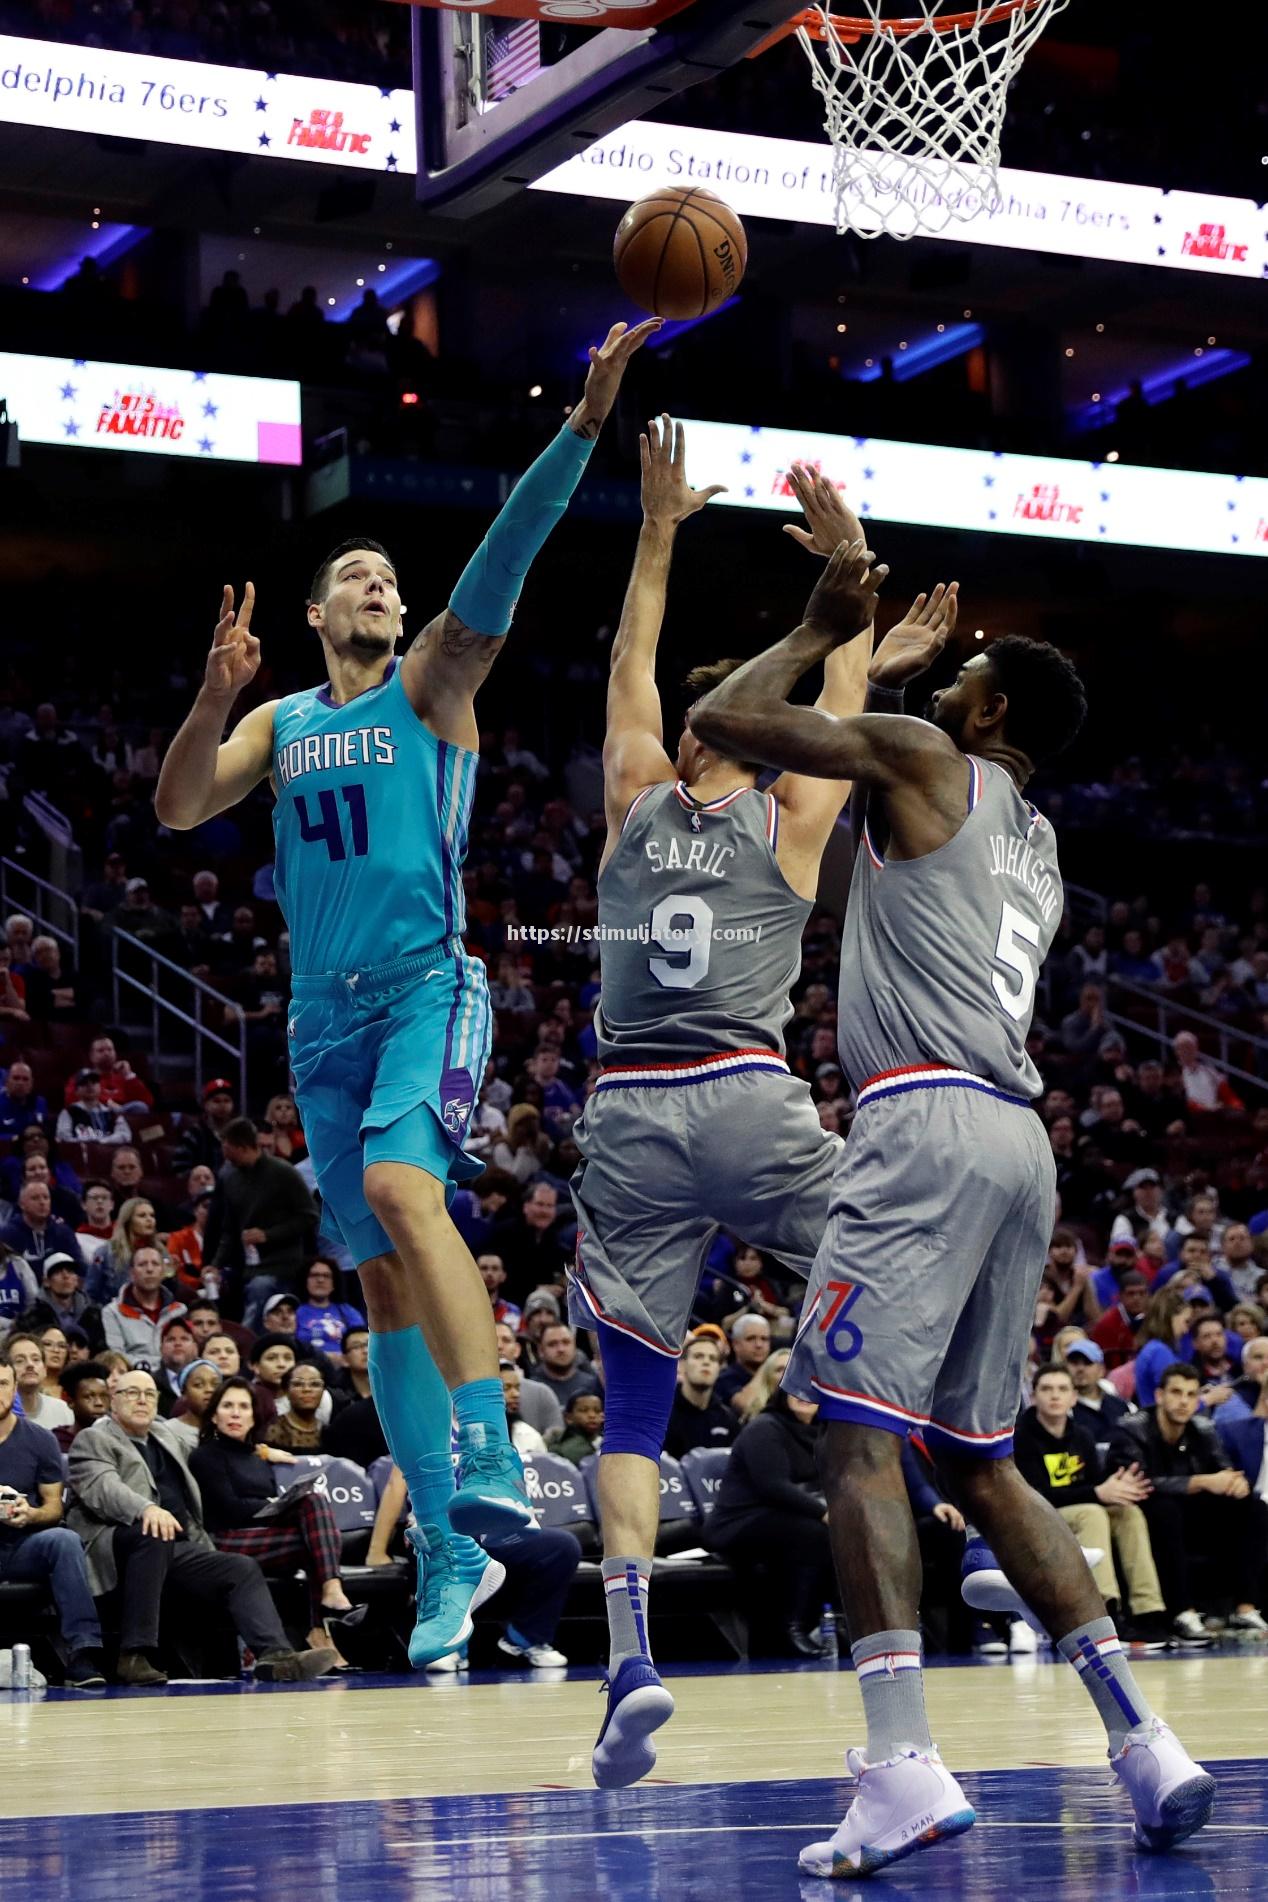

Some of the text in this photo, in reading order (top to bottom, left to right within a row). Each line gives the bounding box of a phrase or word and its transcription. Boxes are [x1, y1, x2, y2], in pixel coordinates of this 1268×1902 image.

[1, 64, 229, 118] delphia 76ers
[578, 144, 654, 172] adio
[666, 149, 769, 186] Station
[782, 166, 809, 190] of
[1058, 200, 1131, 231] 76ers
[96, 412, 184, 439] FANATIC
[276, 726, 399, 786] HORNETS
[293, 783, 369, 862] 41
[645, 837, 735, 878] SARIC
[989, 834, 1058, 923] JOHNSON
[649, 894, 714, 989] 9
[990, 900, 1041, 1022] 5
[818, 1279, 865, 1363] 76
[911, 1813, 935, 1834] MAN
